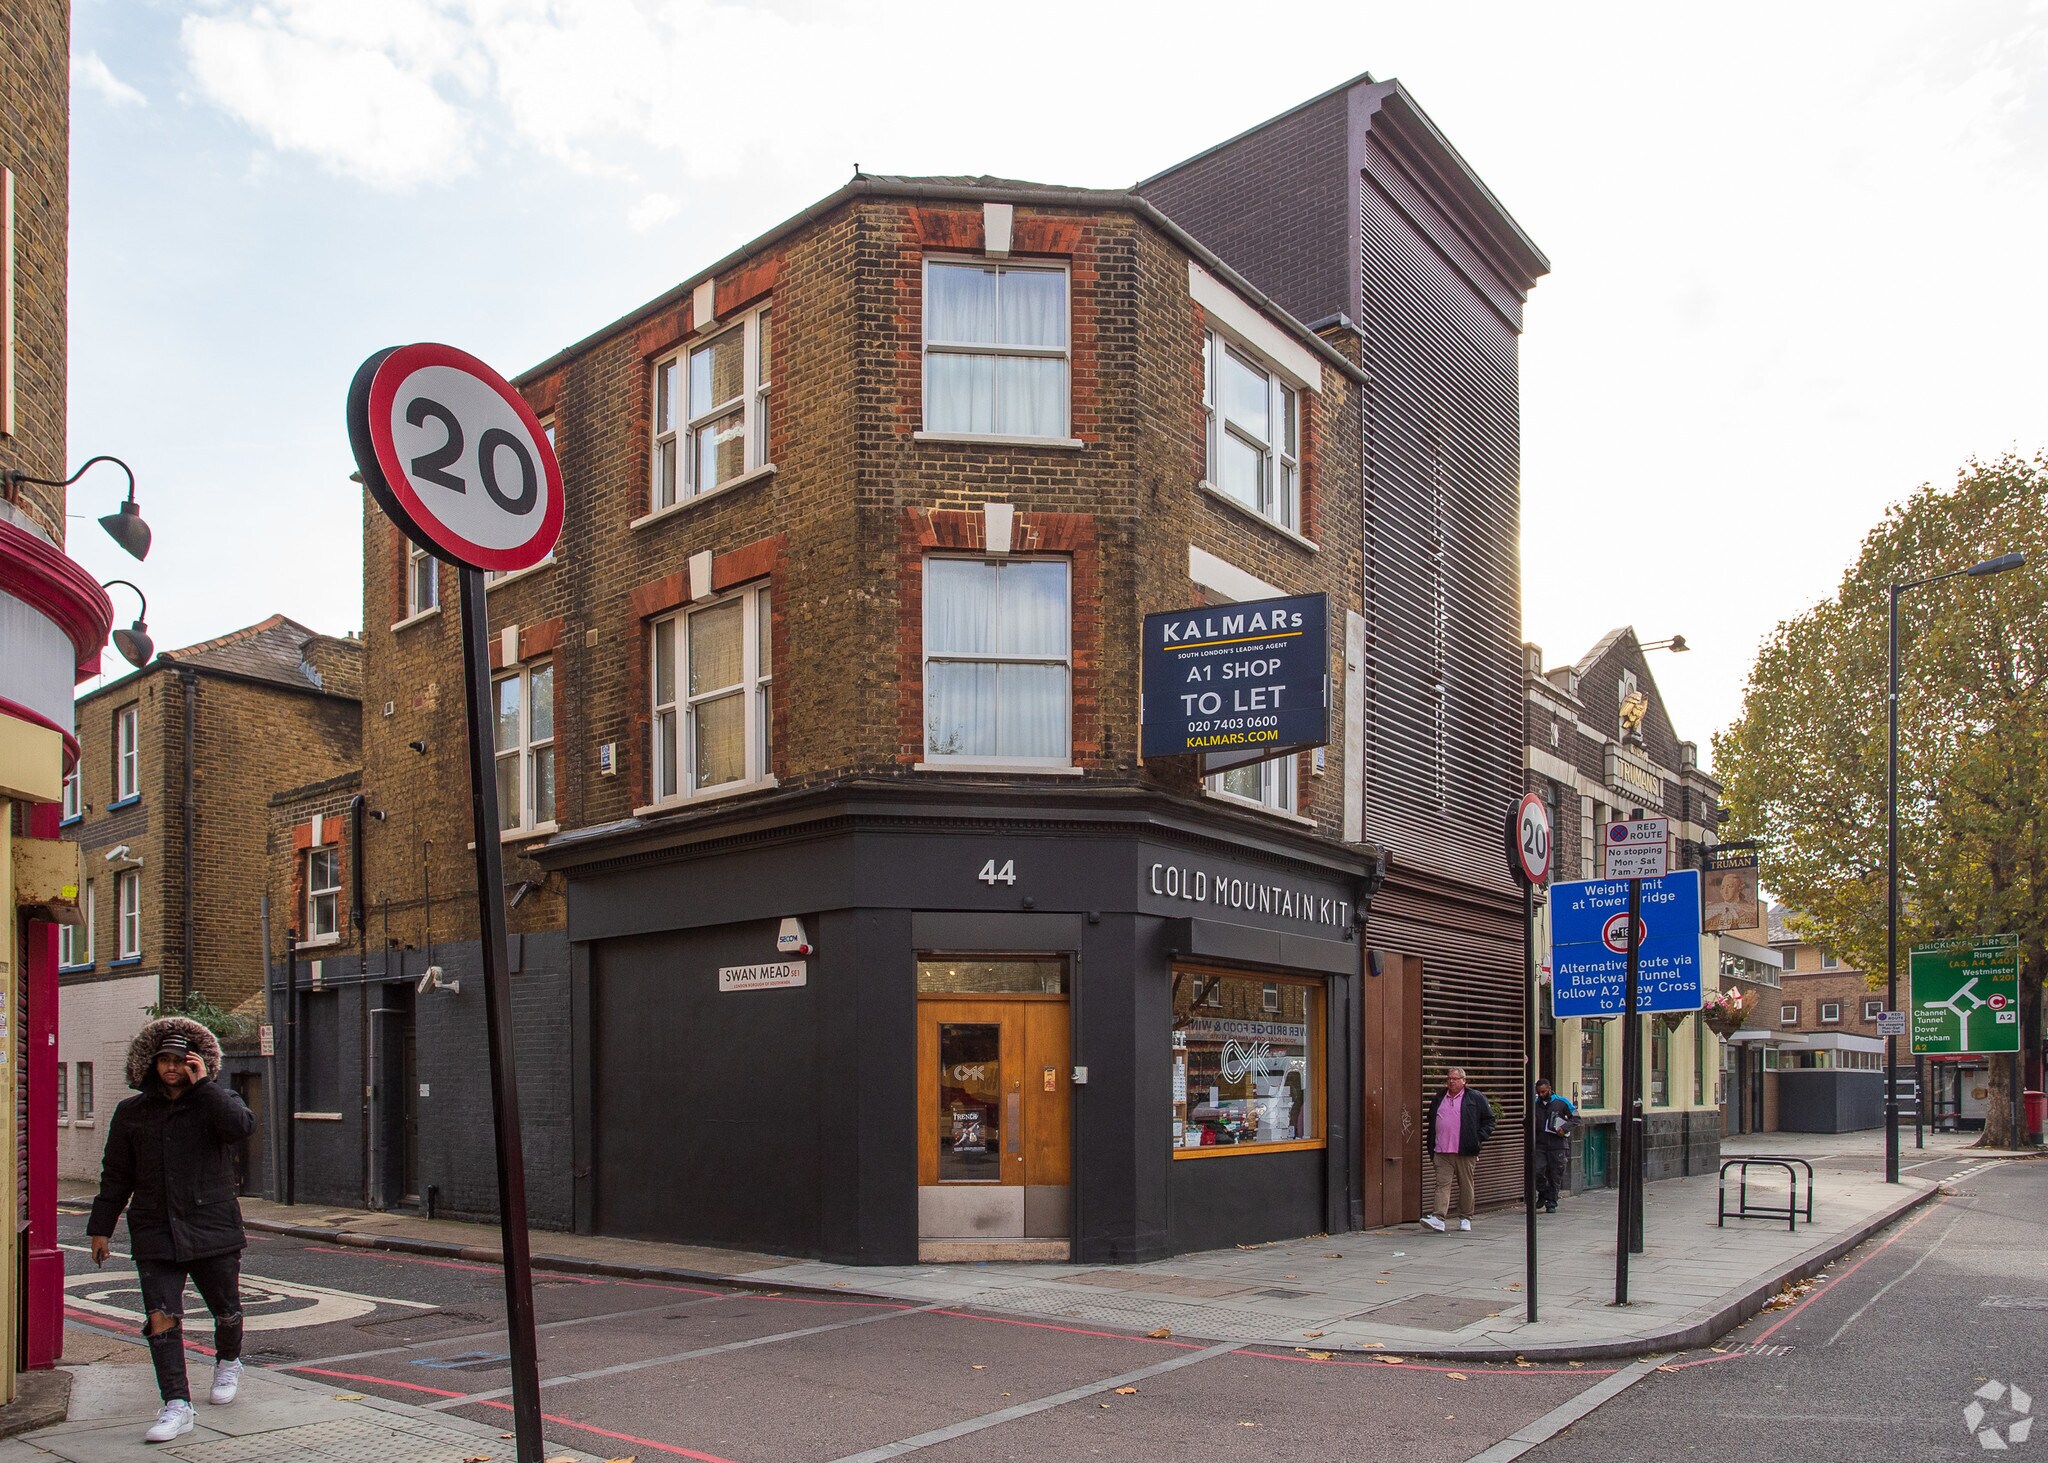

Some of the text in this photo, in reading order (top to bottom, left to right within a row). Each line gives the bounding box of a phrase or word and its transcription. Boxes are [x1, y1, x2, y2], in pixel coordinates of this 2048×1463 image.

[406, 397, 538, 515] 20
[1201, 648, 1234, 657] LONDON'S
[1235, 644, 1264, 653] LEADING
[1265, 642, 1287, 650] AGENT
[1186, 658, 1281, 682] A1 SHOP
[1180, 685, 1286, 716] TO LET
[1188, 715, 1278, 732] 020 7403 0600
[1186, 730, 1278, 747] KALMARS.COM
[1630, 831, 1663, 840] ROUTE
[1637, 823, 1656, 831] RED
[1523, 818, 1546, 859] 20
[1624, 847, 1662, 855] stopping
[1710, 858, 1752, 869] TRUMAN
[979, 860, 1016, 885] 44
[1152, 863, 1348, 927] COLD MOUNTAIN KIT
[1584, 880, 1663, 896] Weight mit
[1572, 891, 1676, 910] at Tower ridge
[1973, 951, 1992, 959] Ring
[1560, 955, 1692, 974] Alternative oute via
[1962, 967, 2014, 976] Westminster
[725, 967, 757, 982] SWAN
[760, 965, 790, 979] MEAD
[1572, 968, 1681, 986] Blackwal Tunnel
[1557, 988, 1596, 999] follow
[1601, 985, 1619, 997] A2
[1658, 981, 1697, 992] Cross
[1600, 996, 1652, 1009] to A02
